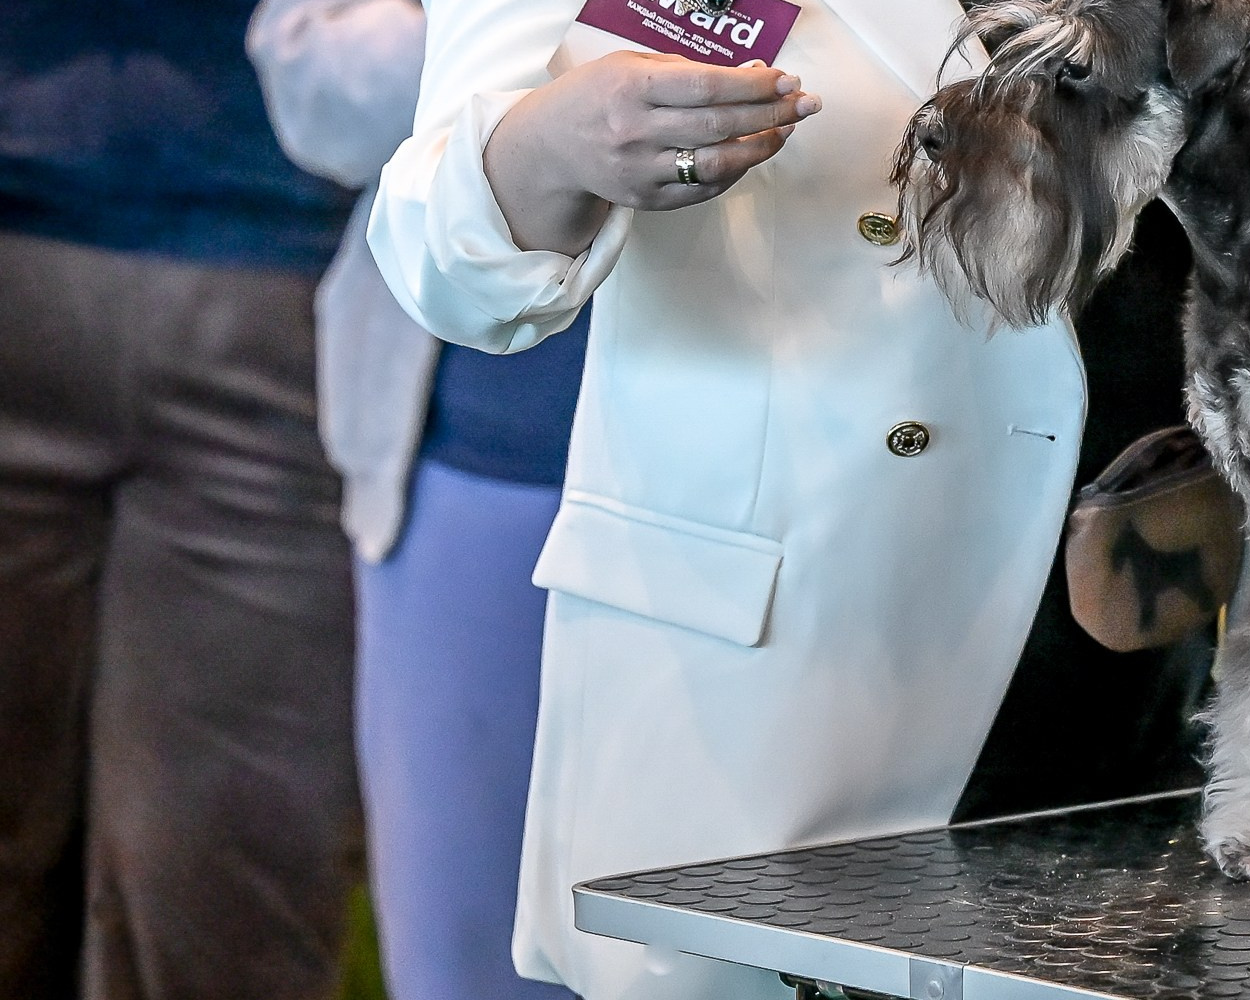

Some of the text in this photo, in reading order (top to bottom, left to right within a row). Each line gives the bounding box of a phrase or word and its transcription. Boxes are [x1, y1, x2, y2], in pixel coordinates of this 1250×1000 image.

[627, 0, 656, 20] КАЖДЫЙ
[655, 15, 685, 36] ПИТОМЕЦ
[691, 33, 704, 43] ЭТО
[642, 18, 680, 42] ДОСТОЙНЫЙ
